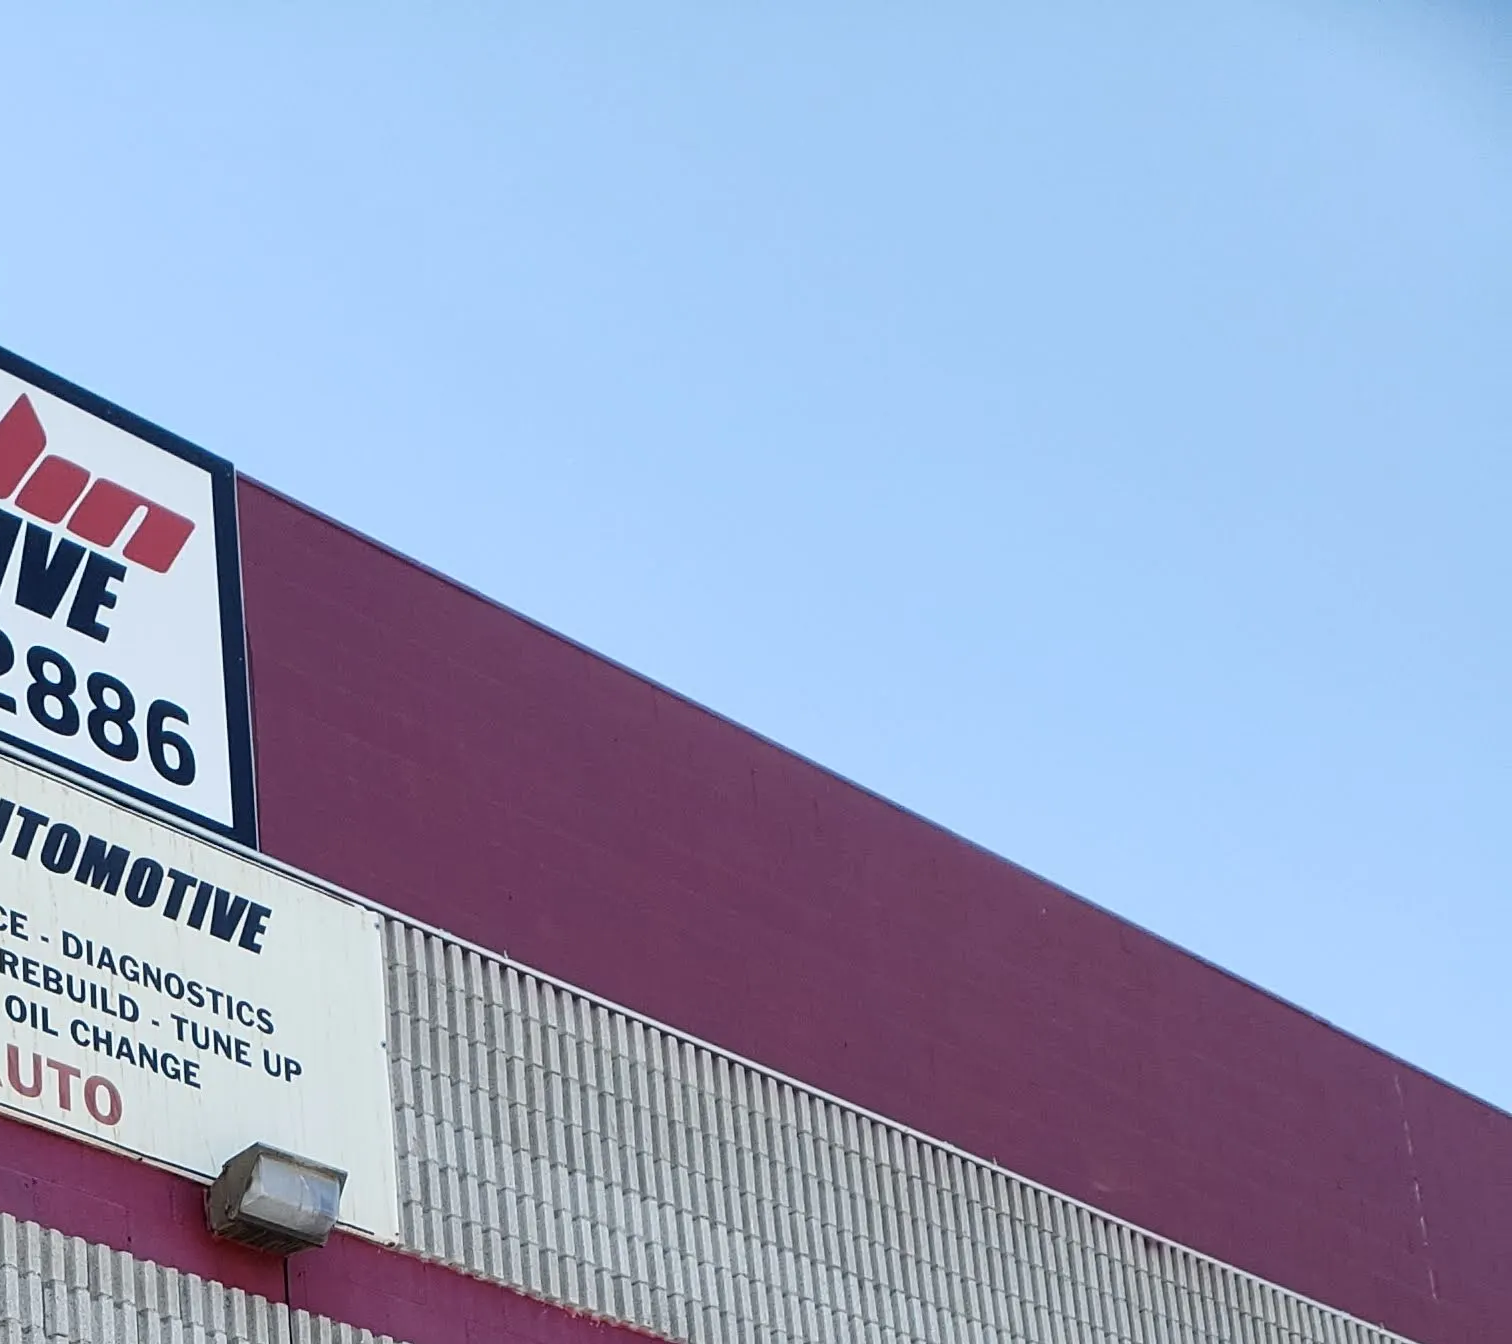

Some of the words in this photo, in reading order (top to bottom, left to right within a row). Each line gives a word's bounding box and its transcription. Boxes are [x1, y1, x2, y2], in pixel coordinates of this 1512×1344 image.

[61, 931, 275, 1035] DIAGNOSTICS
[4, 994, 59, 1036] OIL
[70, 1019, 202, 1089] CHANGE
[174, 1018, 252, 1067] TUNE
[263, 1049, 303, 1083] UP
